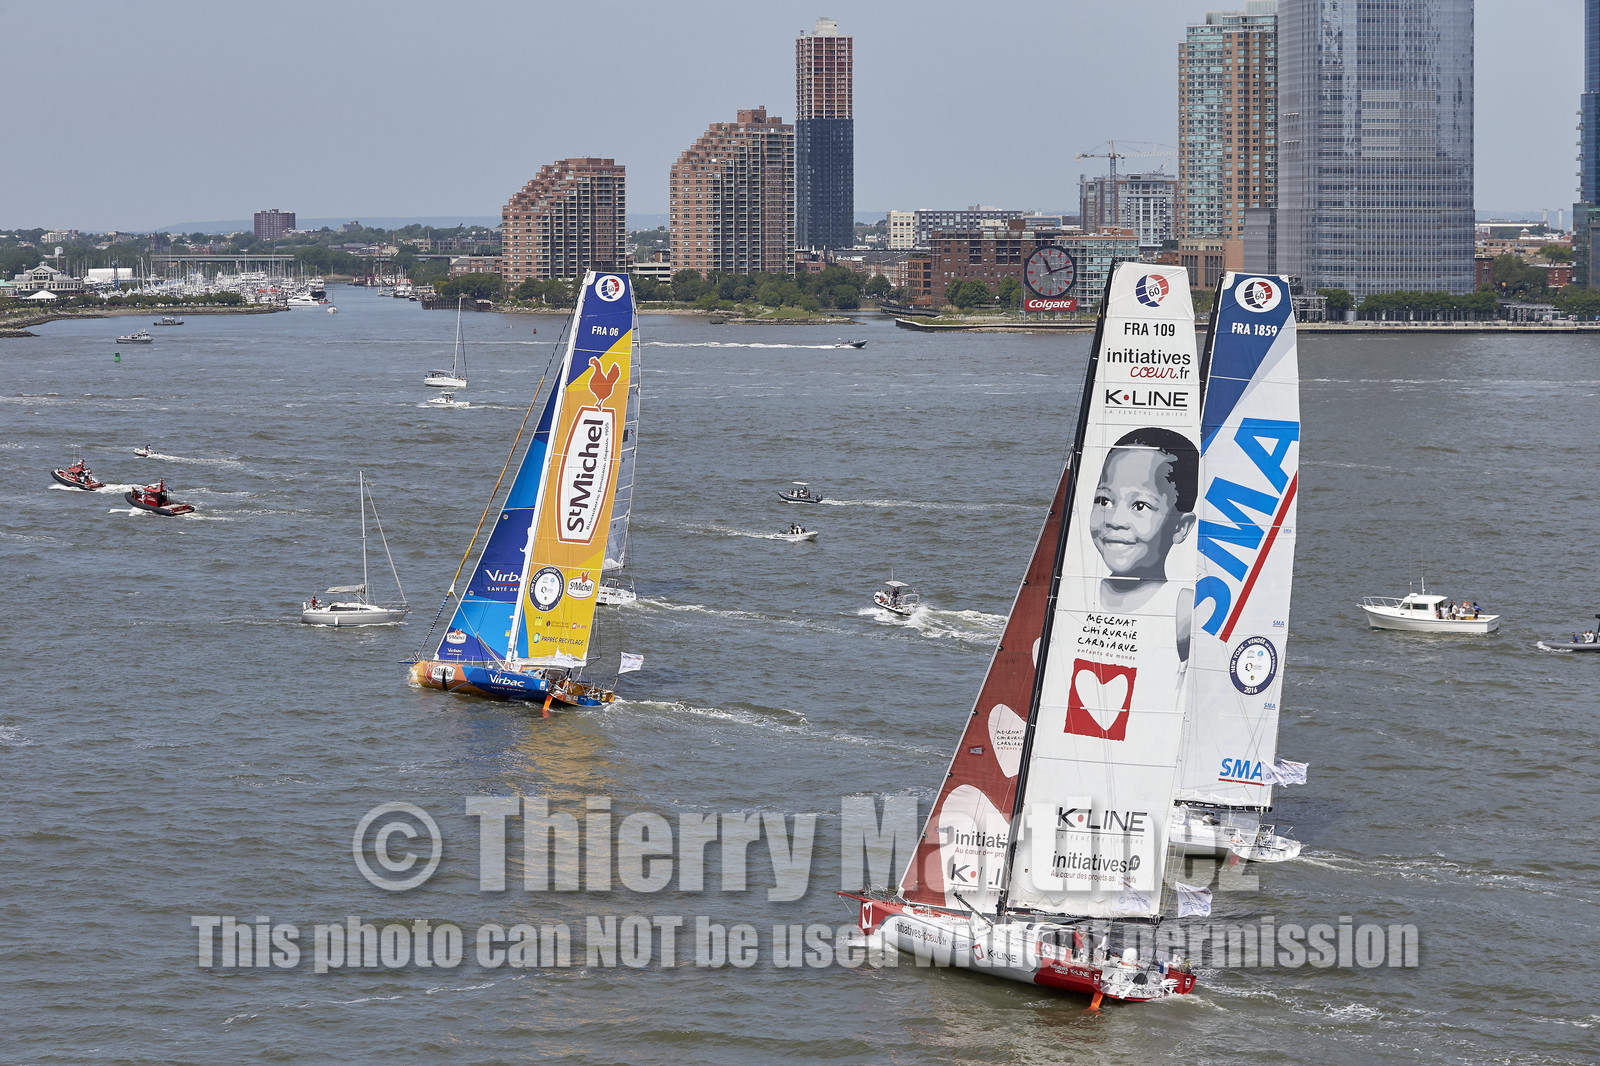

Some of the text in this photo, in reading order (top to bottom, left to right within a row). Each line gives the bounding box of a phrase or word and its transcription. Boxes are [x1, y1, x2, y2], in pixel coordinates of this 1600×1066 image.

[1029, 299, 1071, 310] Colgate
[591, 325, 619, 337] FRA 06
[1124, 322, 1175, 337] FRA 109
[1231, 322, 1278, 337] FRA 1859
[1106, 347, 1191, 365] initiatives
[1193, 417, 1299, 636] SMA
[1077, 648, 1103, 656] enfants
[1232, 644, 1245, 659] YORK
[489, 673, 526, 688] Virbac
[1243, 686, 1258, 694] 2016
[1219, 758, 1262, 781] SMA
[1050, 869, 1059, 878] Au
[1077, 872, 1087, 880] des
[1088, 873, 1107, 882] projets
